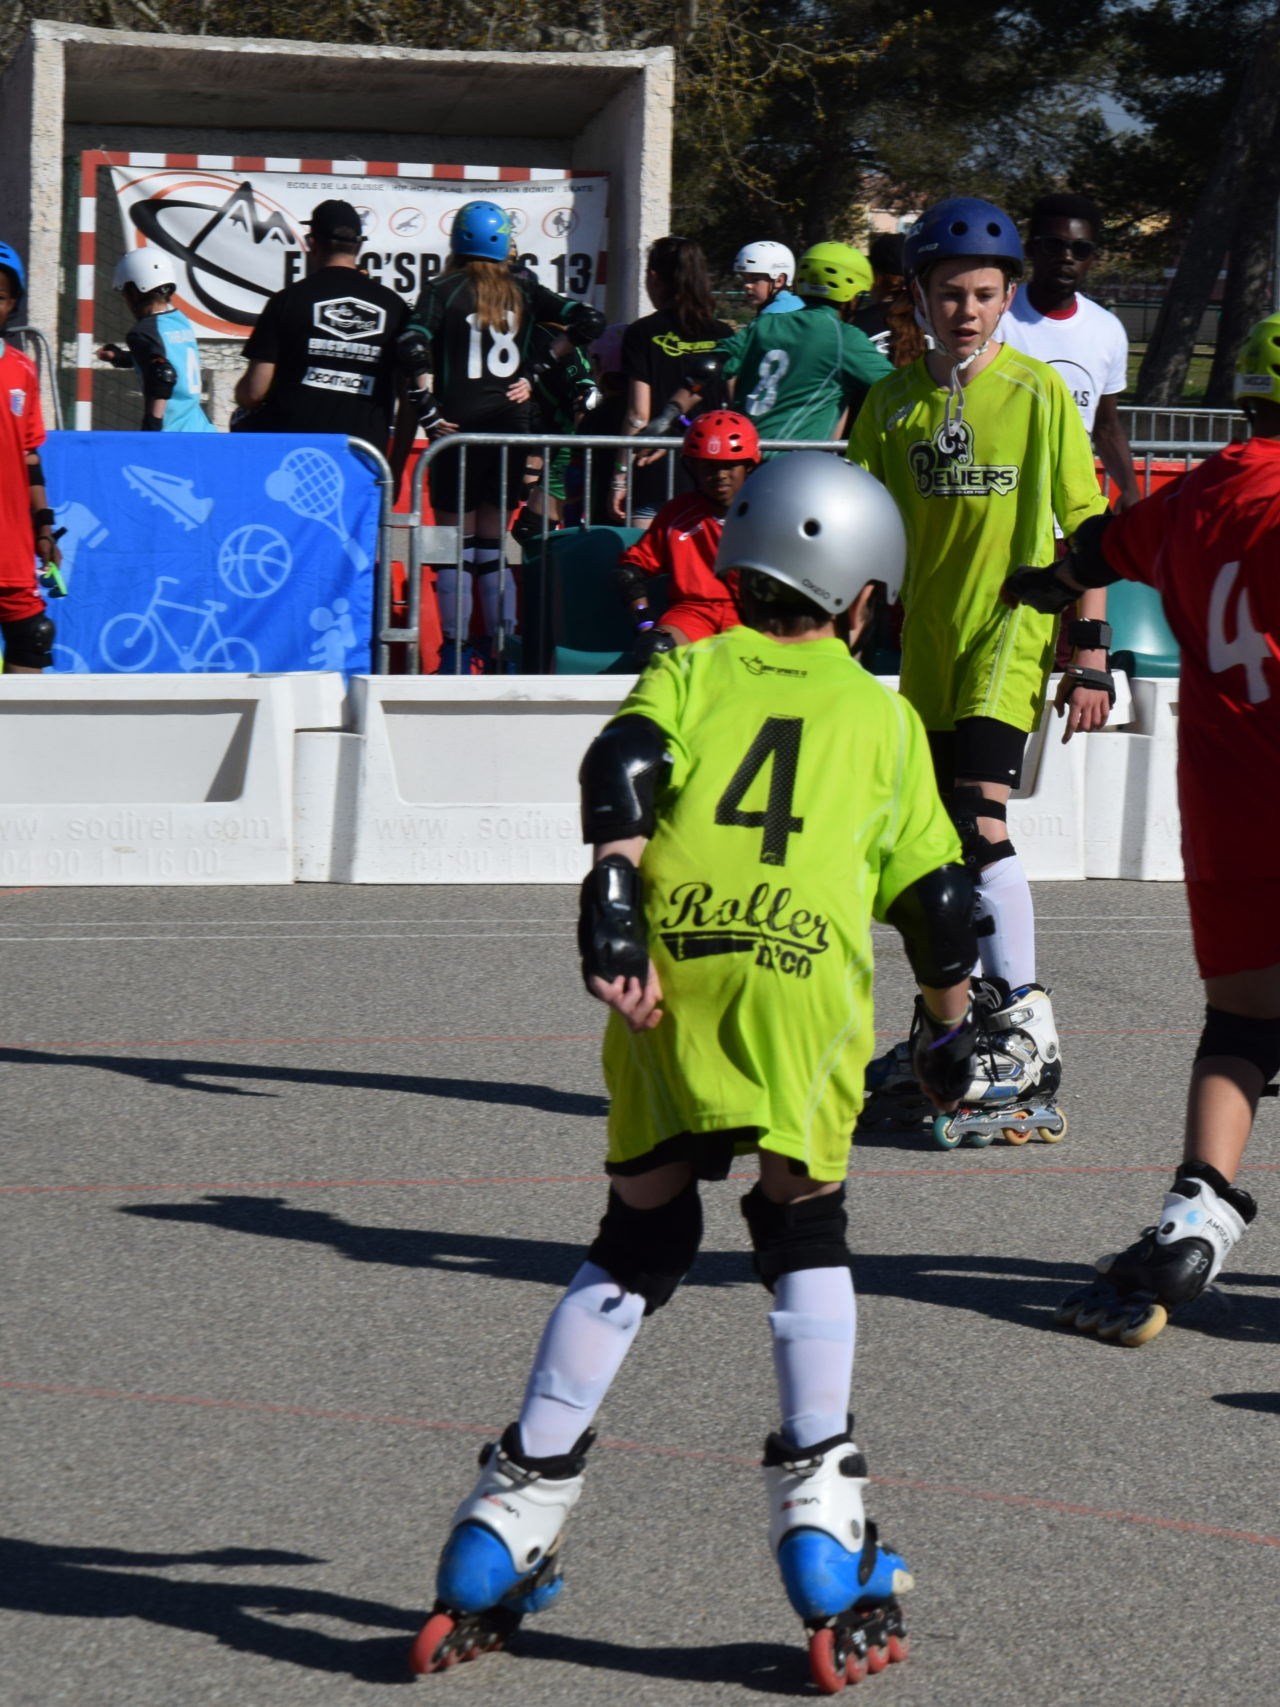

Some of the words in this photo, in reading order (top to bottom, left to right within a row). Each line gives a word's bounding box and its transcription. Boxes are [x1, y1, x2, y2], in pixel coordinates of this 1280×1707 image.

[287, 181, 318, 190] ECOLE
[320, 182, 334, 190] DE
[335, 182, 348, 191] LA
[350, 183, 384, 192] GLISSE
[551, 253, 593, 294] 13
[465, 309, 520, 378] 18
[307, 371, 370, 390] DECATHLON
[746, 349, 789, 416] 8
[1208, 561, 1273, 704] 4
[714, 714, 804, 867] 4
[660, 881, 829, 952] Roller
